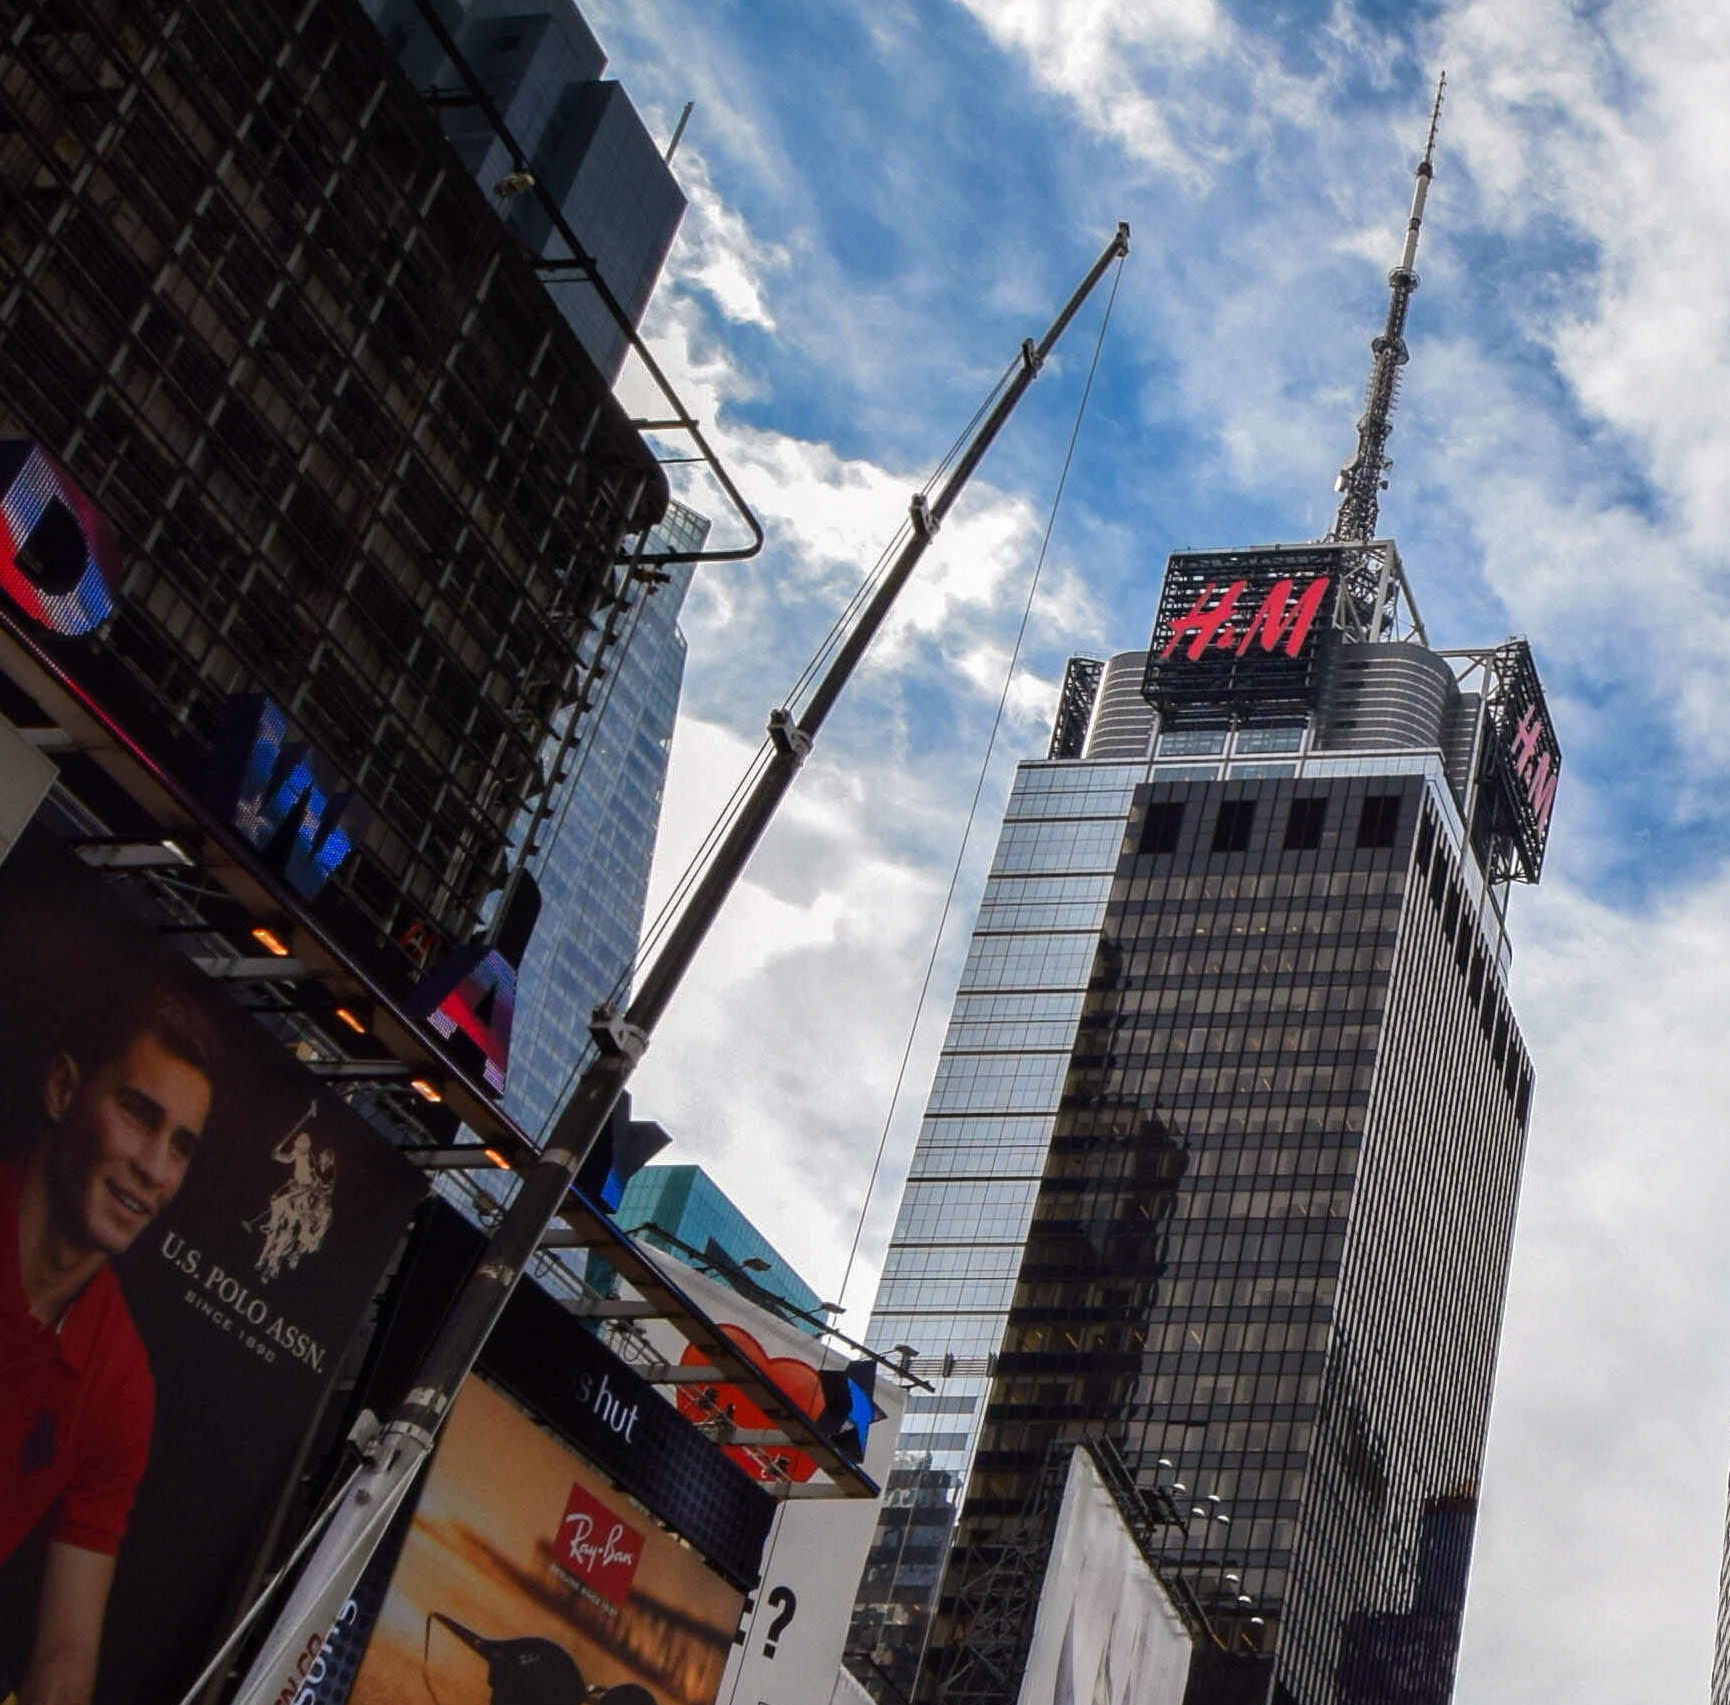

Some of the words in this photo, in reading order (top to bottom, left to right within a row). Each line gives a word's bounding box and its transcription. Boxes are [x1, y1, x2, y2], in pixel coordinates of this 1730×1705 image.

[1161, 576, 1331, 663] H&M
[161, 1230, 202, 1279] U.S.
[203, 1265, 268, 1325] POLO
[265, 1316, 327, 1374] ASSN.
[184, 1289, 235, 1332] SINCE
[593, 1374, 641, 1444] hut
